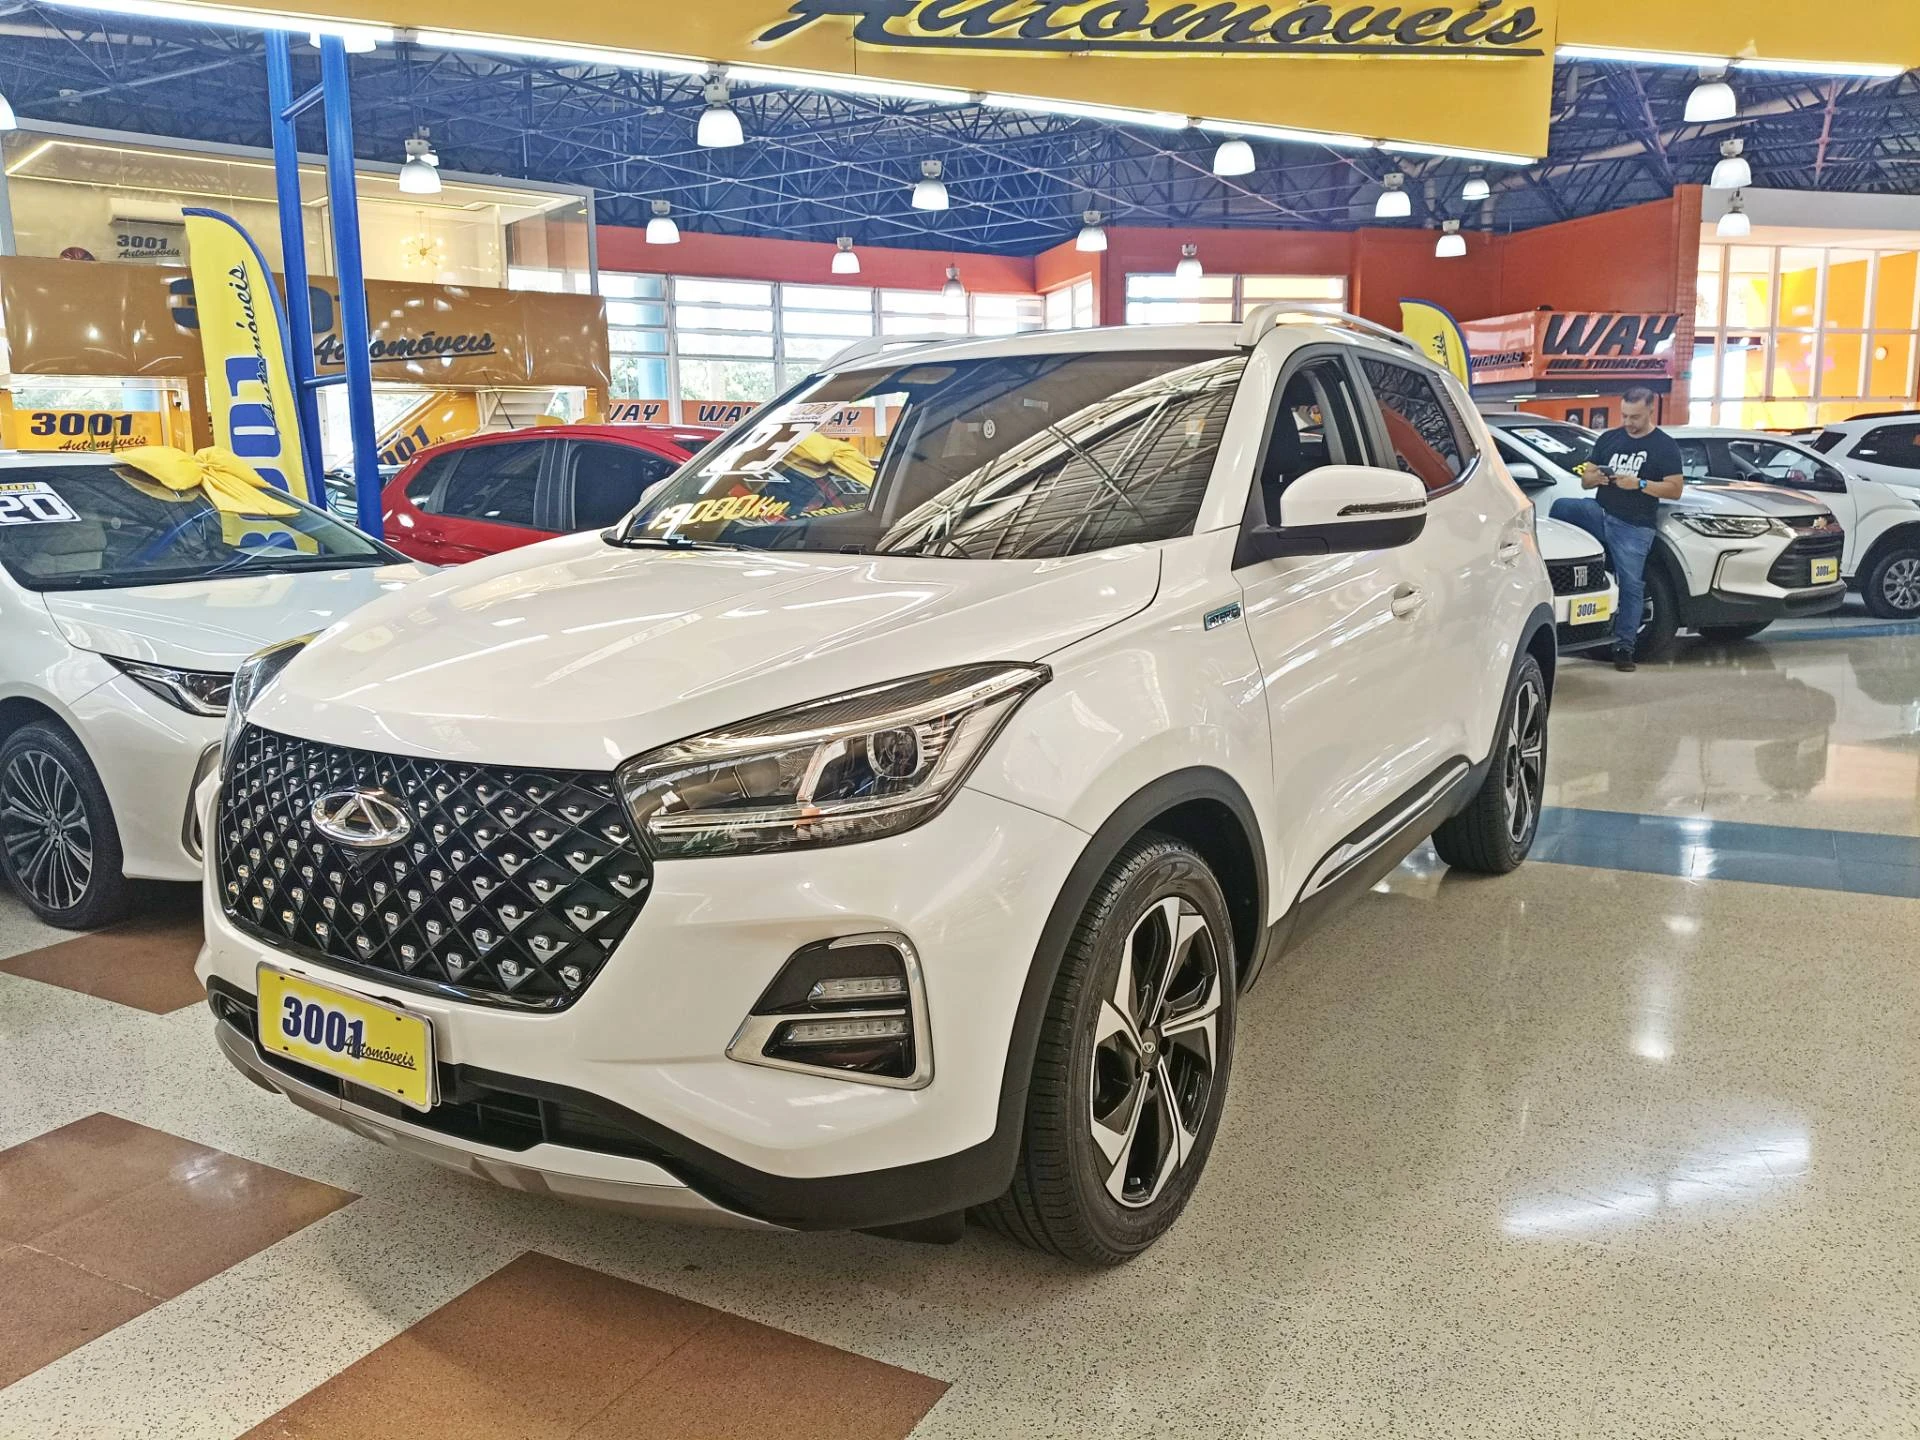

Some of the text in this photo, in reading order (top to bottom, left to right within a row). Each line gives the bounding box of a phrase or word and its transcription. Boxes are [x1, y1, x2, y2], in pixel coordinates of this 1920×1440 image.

[116, 234, 169, 250] 3001
[1543, 314, 1681, 355] WAY
[30, 413, 133, 436] 3001
[1815, 565, 1829, 576] 3001
[1576, 602, 1597, 618] 3001
[282, 996, 364, 1060] 3001
